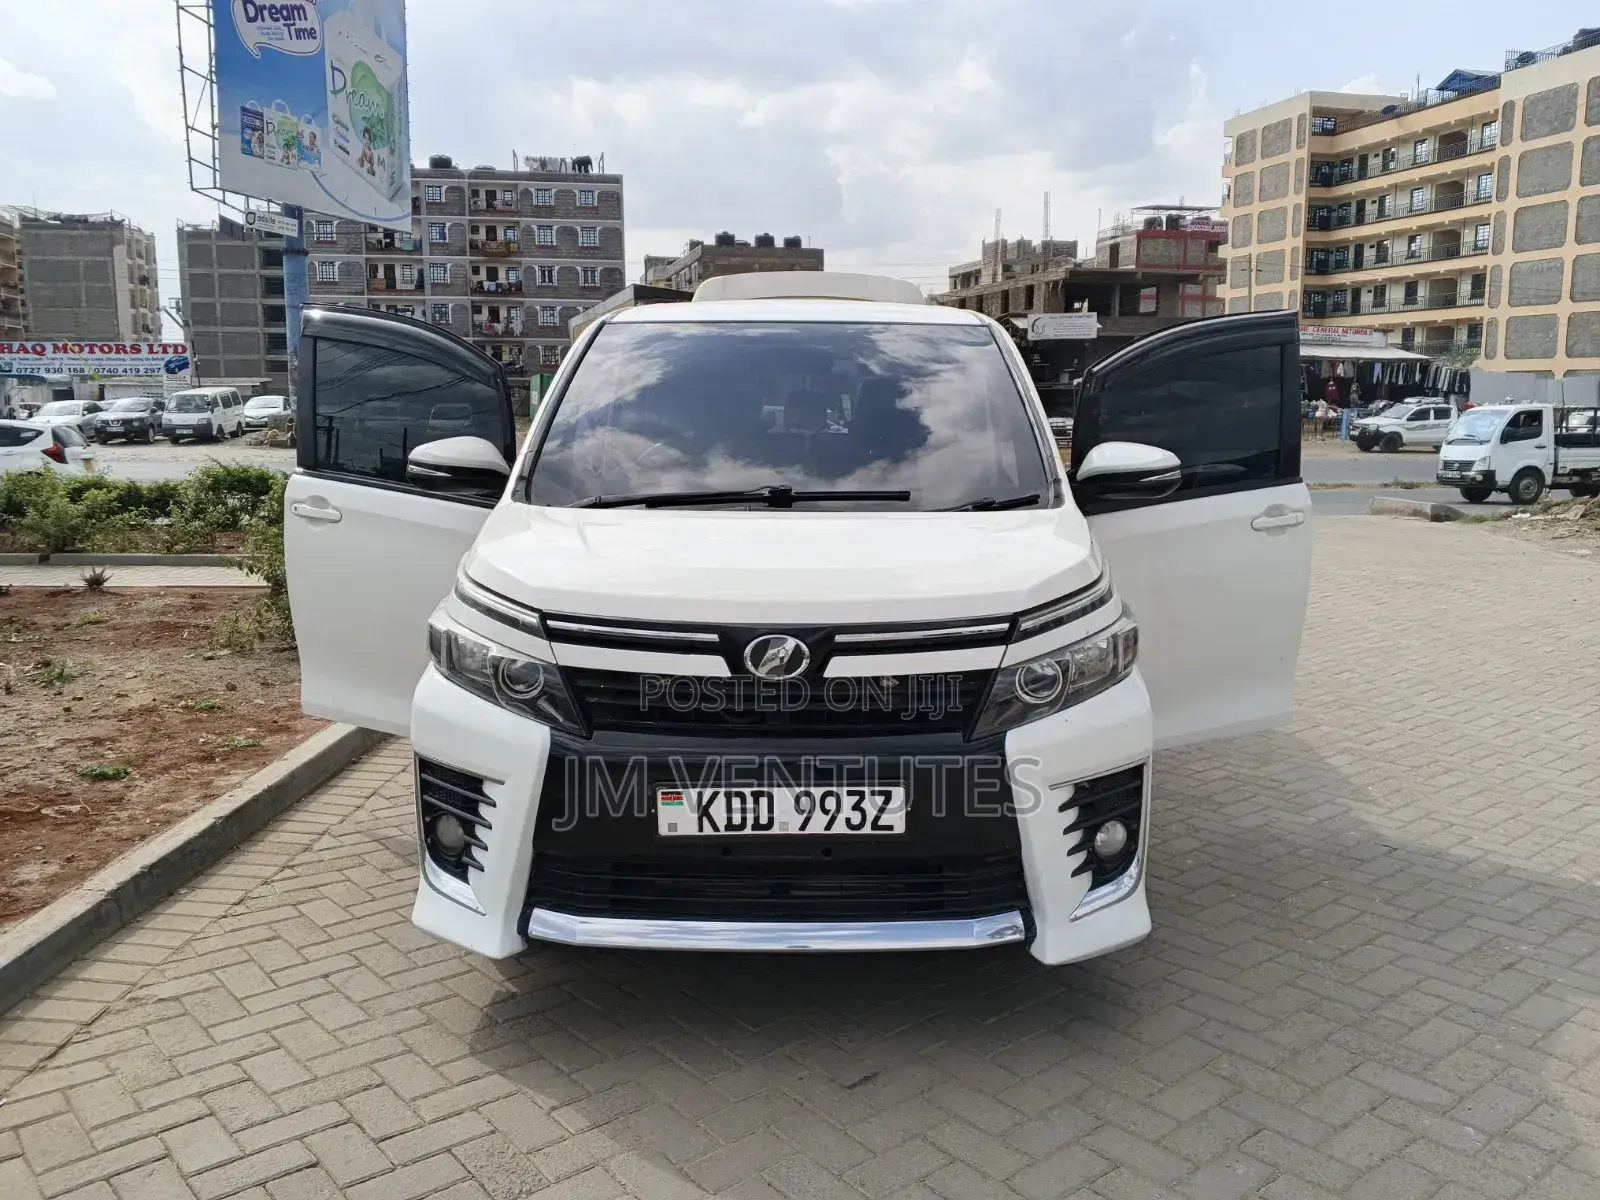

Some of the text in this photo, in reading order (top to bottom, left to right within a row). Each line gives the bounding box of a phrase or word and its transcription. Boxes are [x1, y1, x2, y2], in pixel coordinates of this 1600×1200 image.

[242, 0, 308, 23] Dream
[283, 22, 317, 40] Time
[330, 59, 384, 118] Dream
[51, 343, 142, 355] MOTORS
[147, 343, 188, 354] LTD
[697, 789, 895, 832] KDD 993Z
